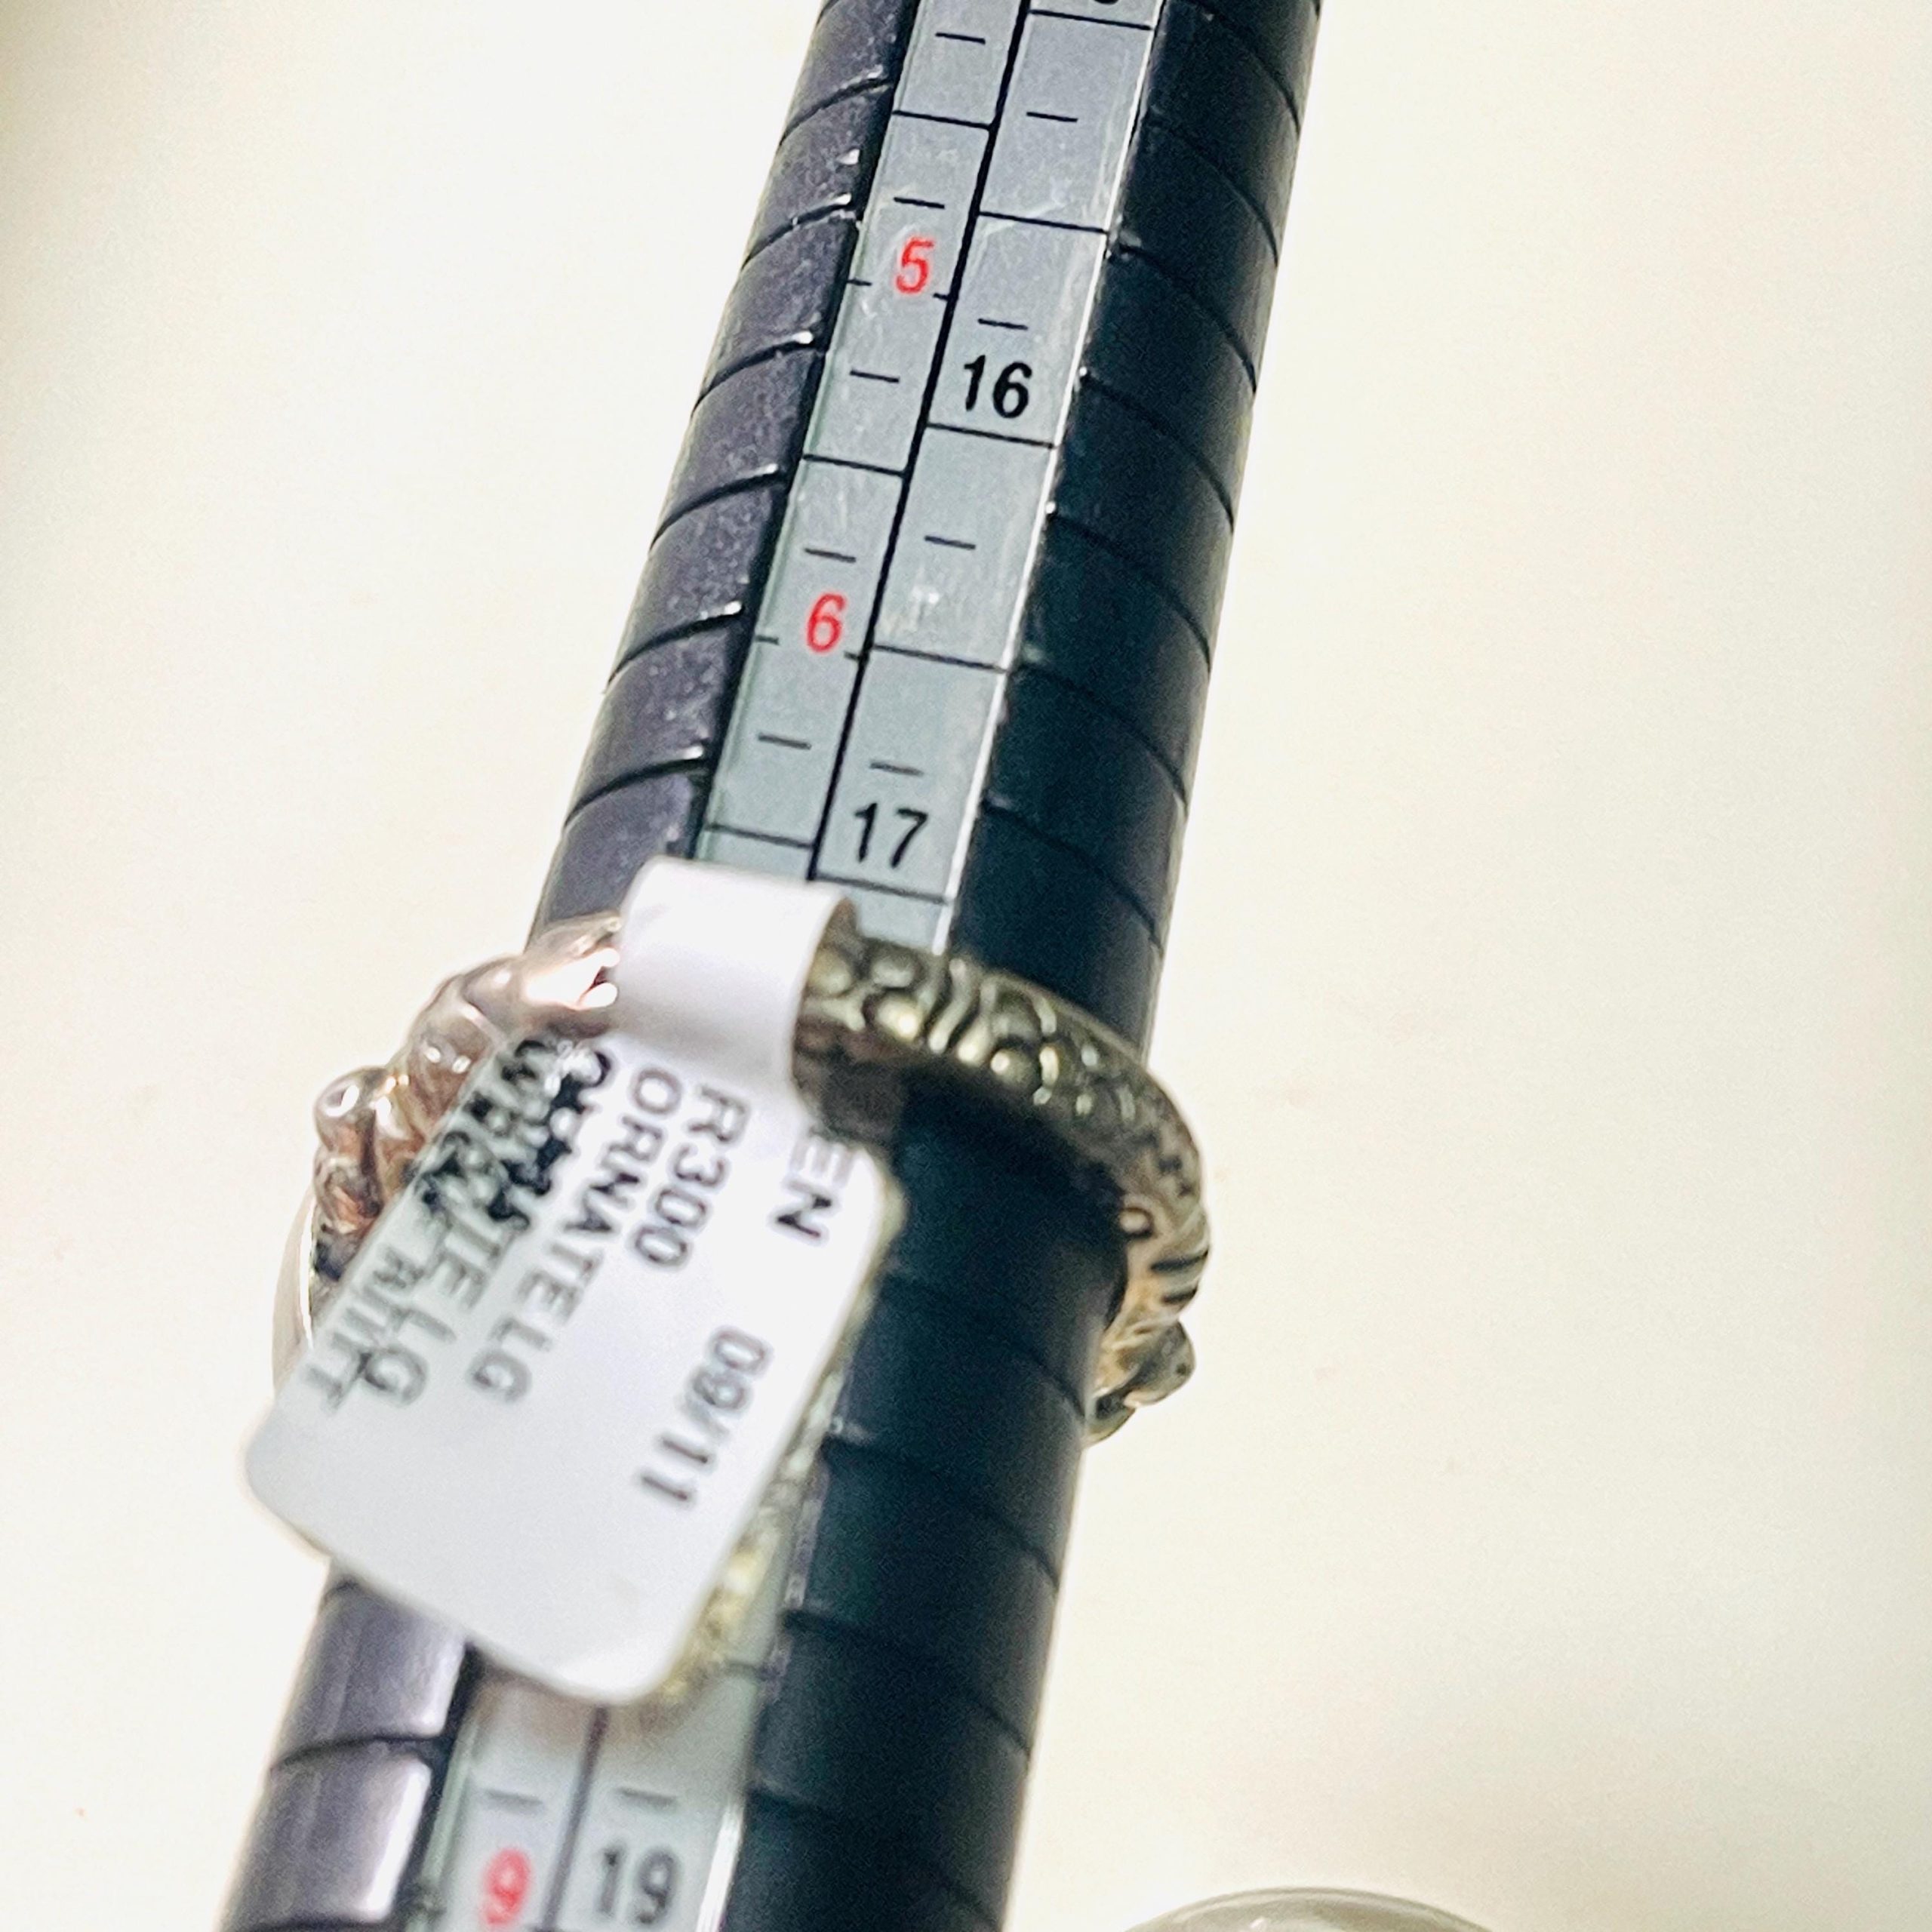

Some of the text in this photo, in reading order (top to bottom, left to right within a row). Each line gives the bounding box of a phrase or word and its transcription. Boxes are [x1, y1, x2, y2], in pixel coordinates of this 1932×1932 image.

[894, 238, 934, 294] 5
[963, 355, 1032, 418] 16
[806, 593, 845, 653] 6
[855, 802, 928, 868] 17
[517, 1068, 683, 1324] ORNATE
[629, 1083, 752, 1269] R300
[471, 1313, 555, 1404] LG
[481, 1845, 531, 1925] 9
[600, 1841, 675, 1924] 19
